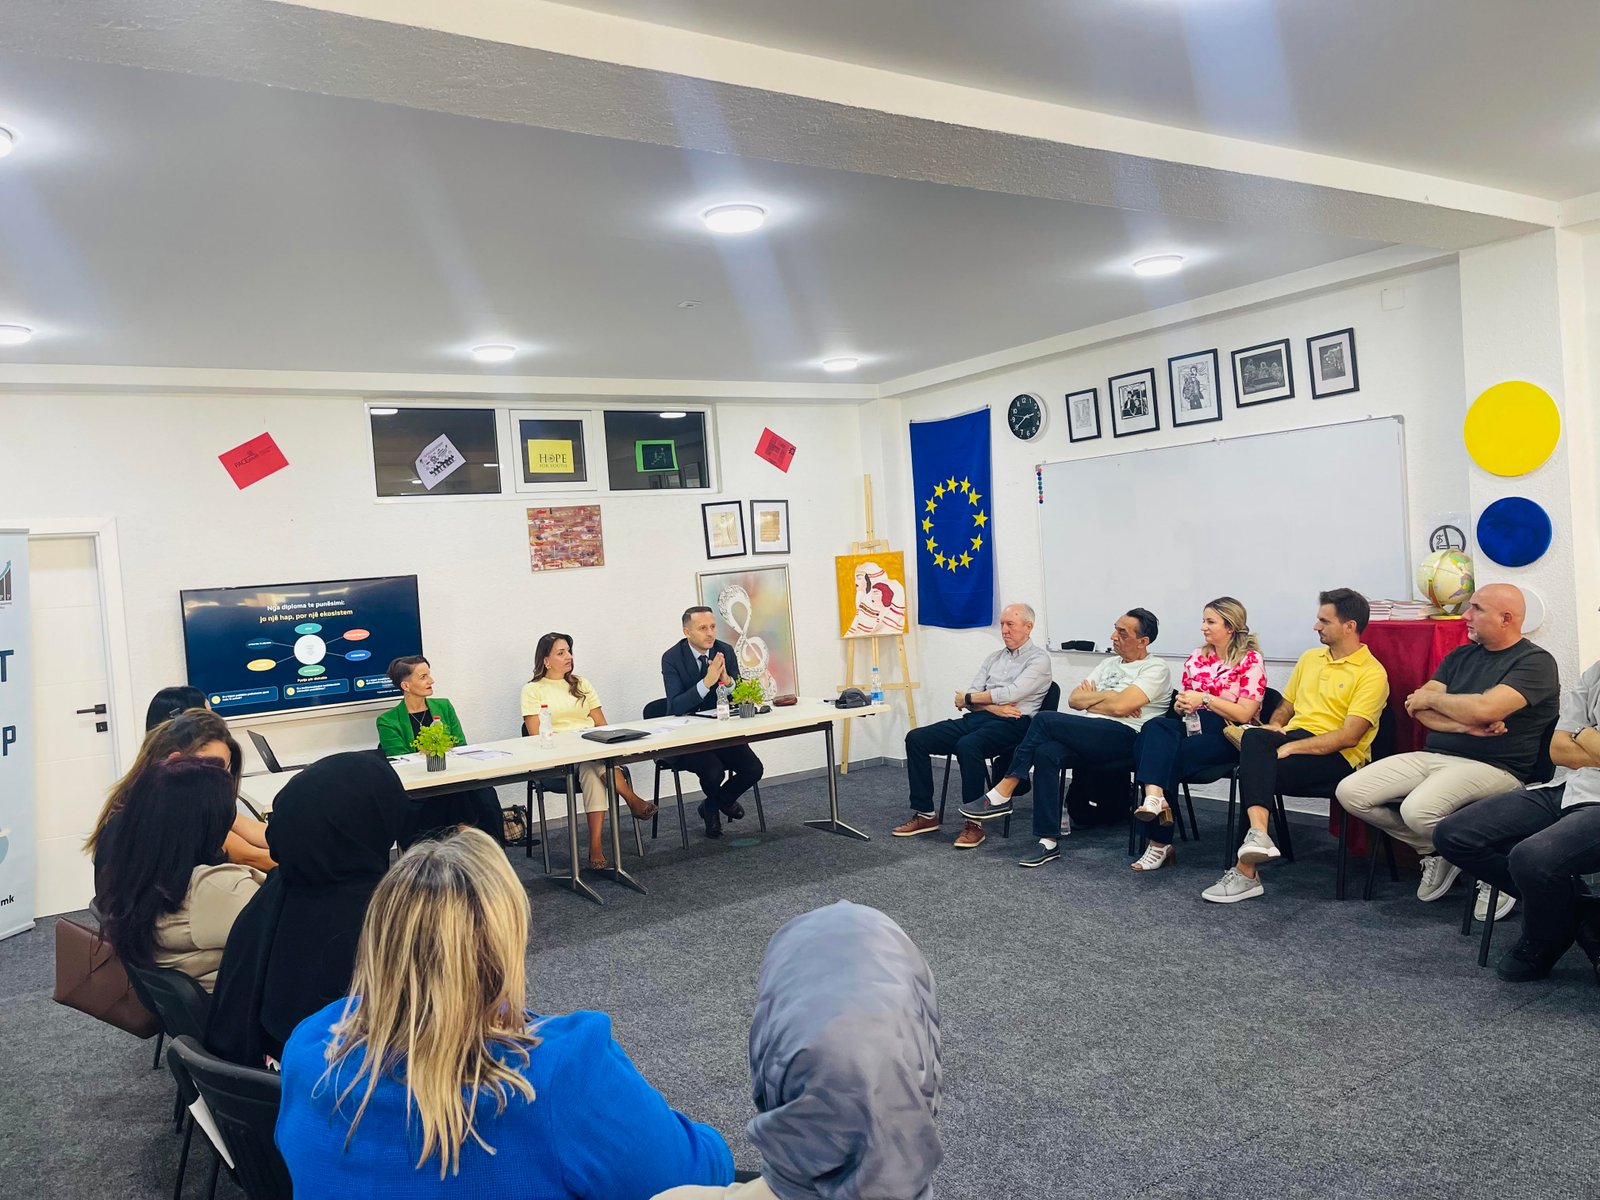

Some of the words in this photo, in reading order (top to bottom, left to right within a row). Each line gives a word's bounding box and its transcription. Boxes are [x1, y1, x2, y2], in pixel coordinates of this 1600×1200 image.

[539, 454, 567, 463] HOPE
[281, 603, 306, 611] diploma
[268, 615, 278, 623] një
[308, 611, 318, 619] një
[320, 609, 353, 617] ekosistem
[0, 649, 14, 683] T
[2, 724, 17, 757] P
[0, 894, 15, 906] mk
